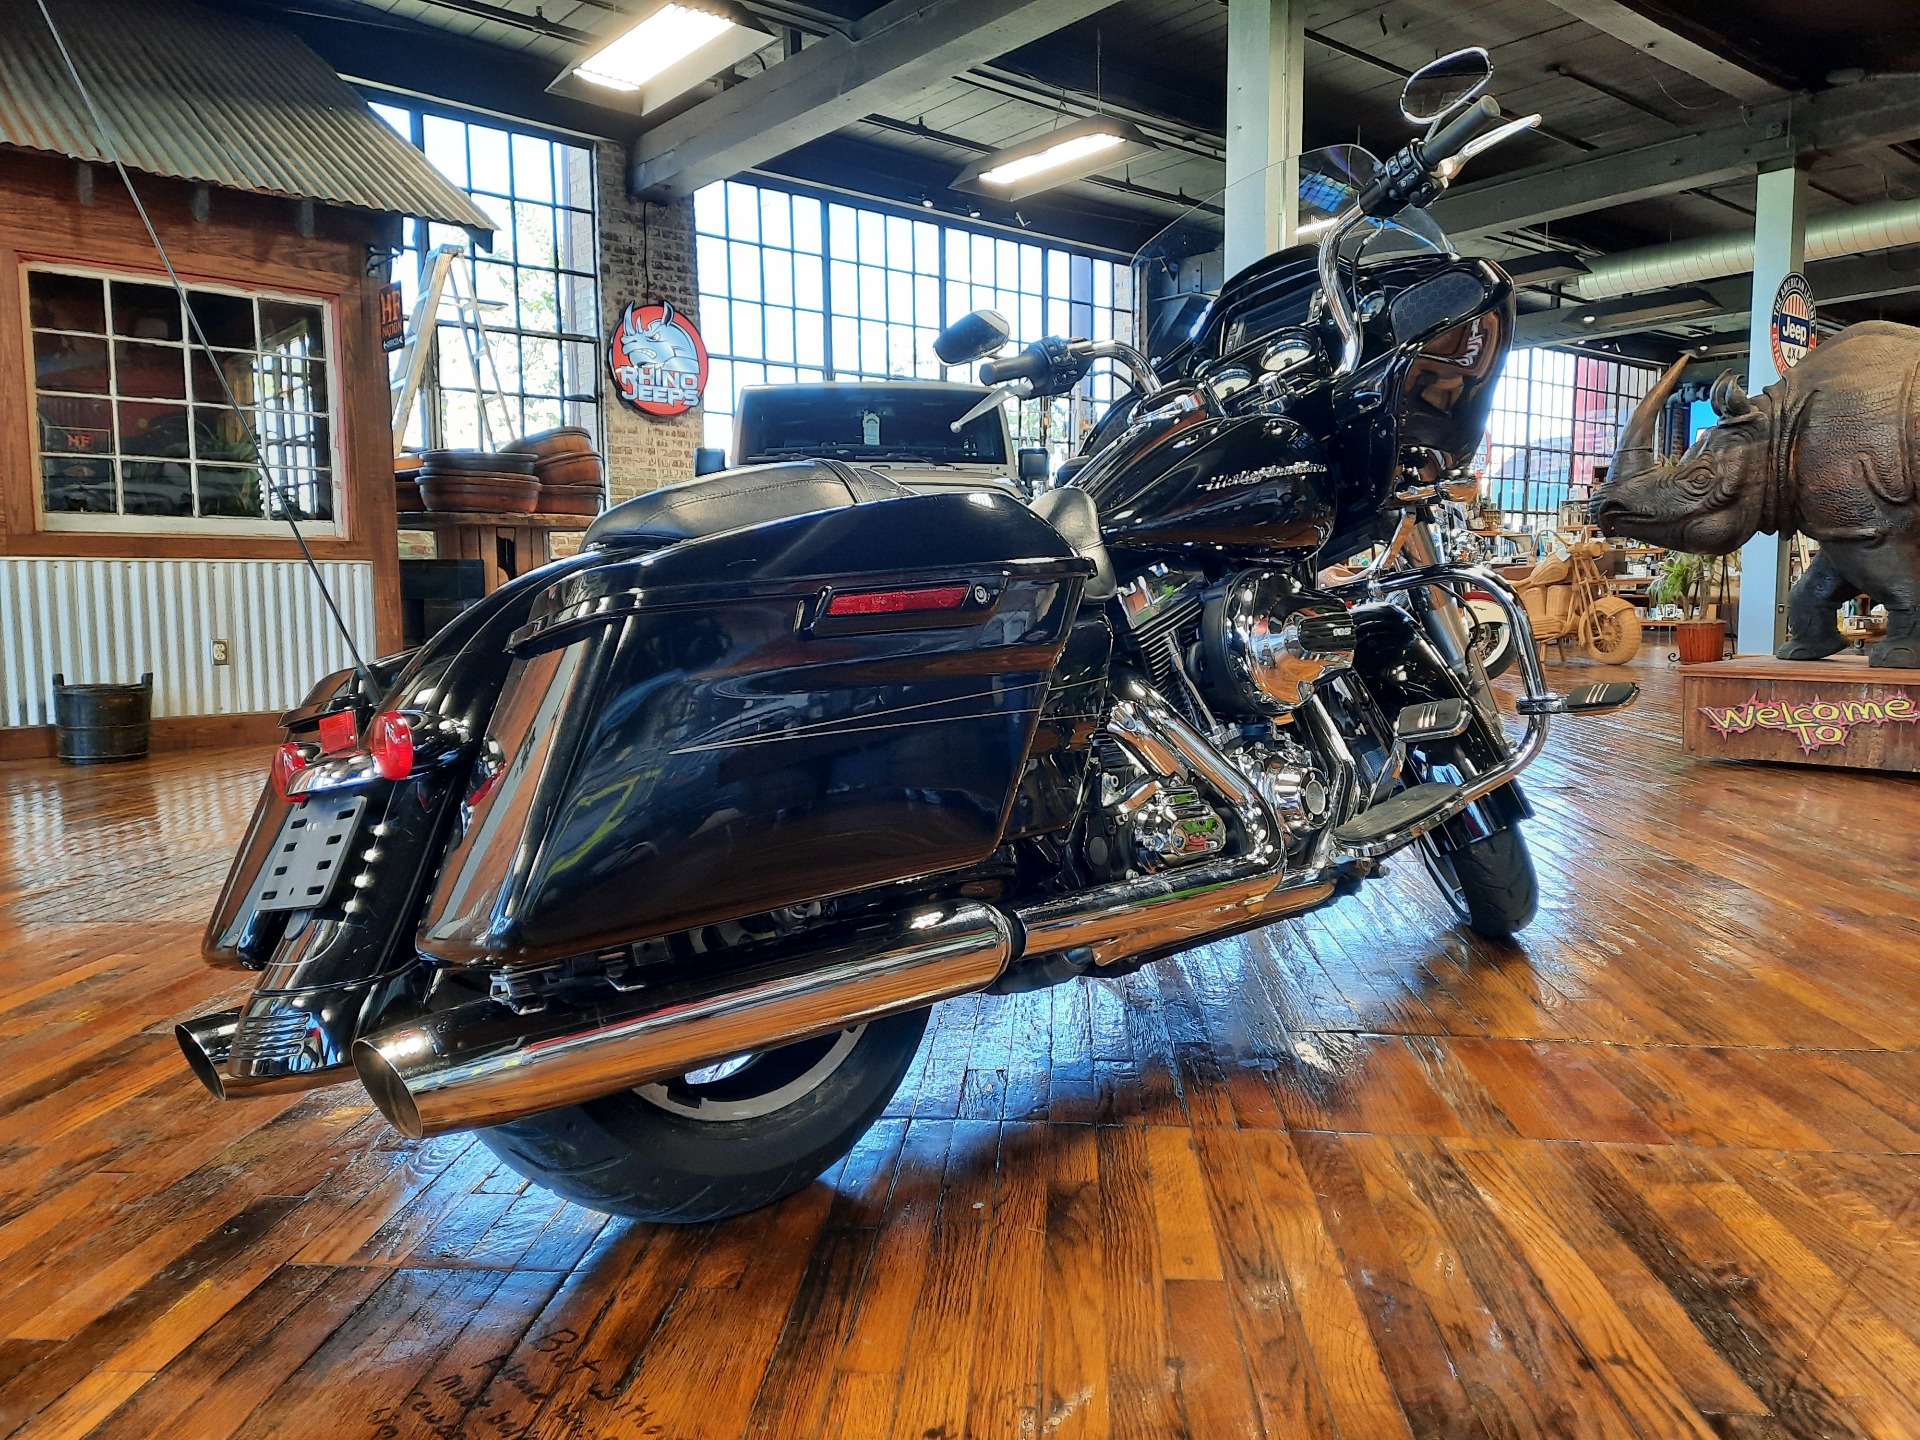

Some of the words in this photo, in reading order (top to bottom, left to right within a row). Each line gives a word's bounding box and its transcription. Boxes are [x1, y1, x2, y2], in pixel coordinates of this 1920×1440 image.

[380, 290, 401, 325] HF
[1773, 295, 1783, 317] THE
[1780, 277, 1805, 299] AMERICAN
[1782, 316, 1807, 346] Jeep
[620, 365, 699, 390] RHINO
[621, 384, 700, 407] JEEPS
[1705, 699, 1918, 729] Welcome
[1786, 723, 1843, 746] To
[531, 1328, 602, 1374] But
